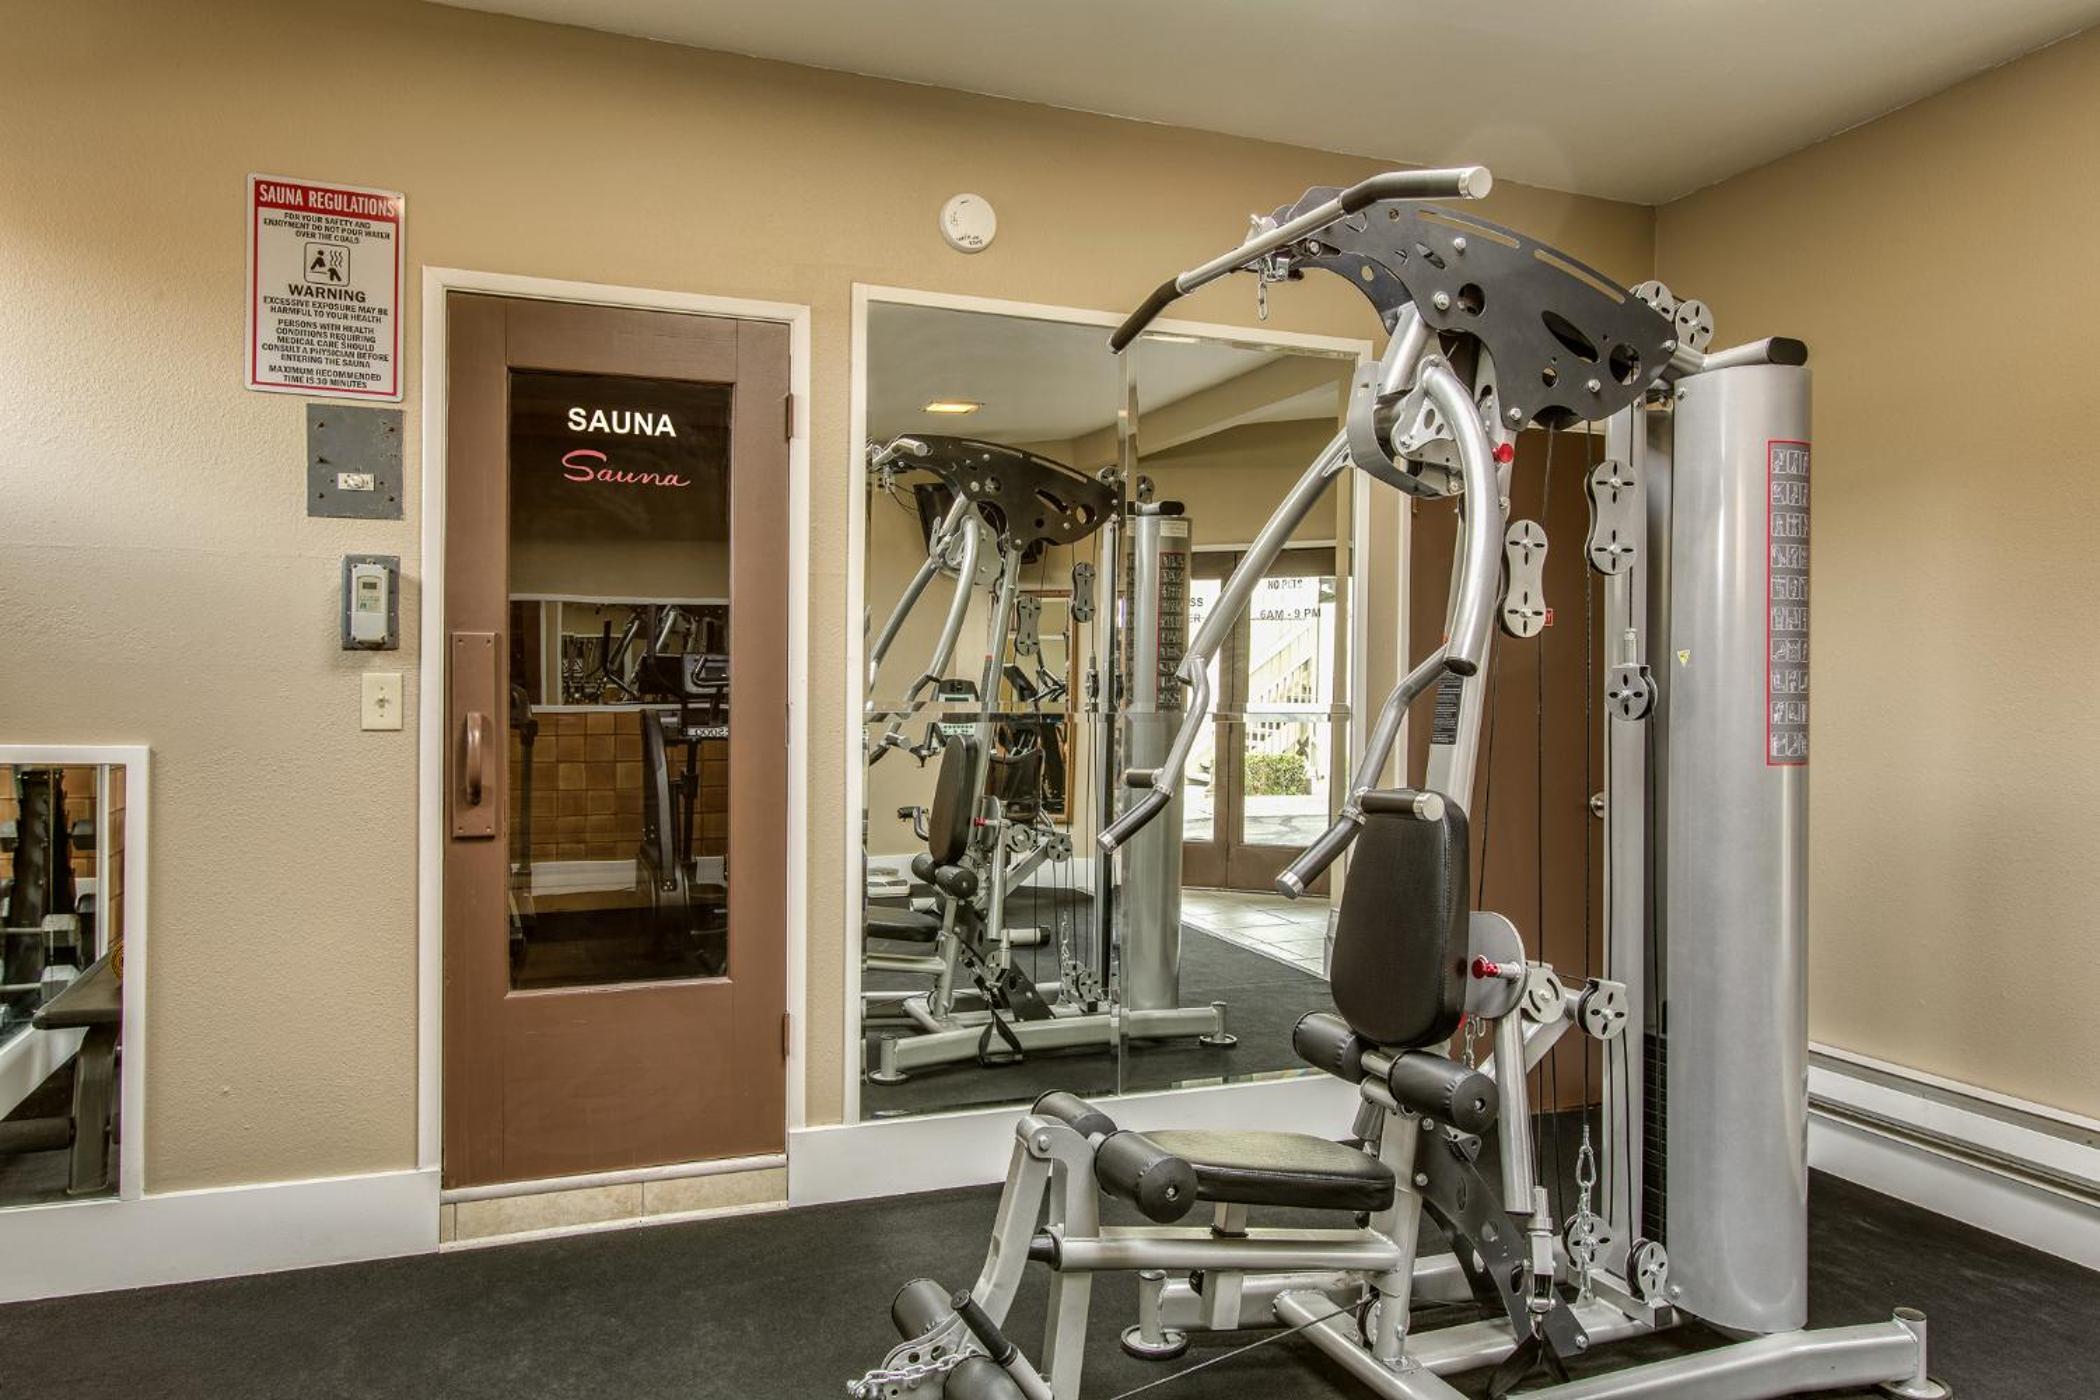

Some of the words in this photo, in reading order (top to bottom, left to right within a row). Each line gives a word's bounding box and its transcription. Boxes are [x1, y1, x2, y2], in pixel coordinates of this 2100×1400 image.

[259, 184, 303, 205] SAUNA
[309, 191, 395, 217] REGULATIONS
[264, 218, 309, 230] ENJOYMENT
[312, 224, 322, 232] DO
[325, 225, 339, 233] NOT
[341, 228, 363, 236] POUR
[285, 213, 300, 221] FOR
[302, 215, 322, 223] YOUR
[325, 217, 353, 227] SAFETY
[355, 221, 371, 229] AND
[295, 231, 316, 240] OVER
[318, 233, 332, 241] THE
[334, 235, 359, 244] COALS
[289, 284, 366, 303] WARNING
[264, 296, 310, 307] EXCESSIVE
[312, 303, 356, 312] EXPOSURE
[270, 306, 312, 317] HARMFUL
[326, 312, 348, 320] YOUR
[351, 314, 382, 323] HEALTH
[278, 319, 317, 329] PERSONS
[319, 323, 340, 331] WITH
[343, 325, 375, 334] HEALTH
[276, 328, 328, 339] CONDITIONS
[330, 332, 376, 343] REQUIRING
[277, 336, 315, 345] MEDICAL
[317, 340, 339, 348] CARE
[341, 342, 374, 351] SHOULD
[262, 343, 301, 353] CONSULT
[311, 348, 355, 358] PHYSICIAN
[357, 352, 389, 362] BEFORE
[281, 354, 322, 364] ENTERING
[343, 359, 370, 368] SAUNA
[269, 365, 314, 375] MAXIMUM
[316, 370, 381, 381] RECOMMENDED
[284, 375, 303, 383] TIME
[330, 379, 367, 388] MINUTES
[568, 407, 676, 437] SAUNA
[562, 449, 691, 487] Sauna
[1268, 580, 1278, 589] NO
[1260, 609, 1284, 620] 6AM
[1304, 608, 1321, 618] PM
